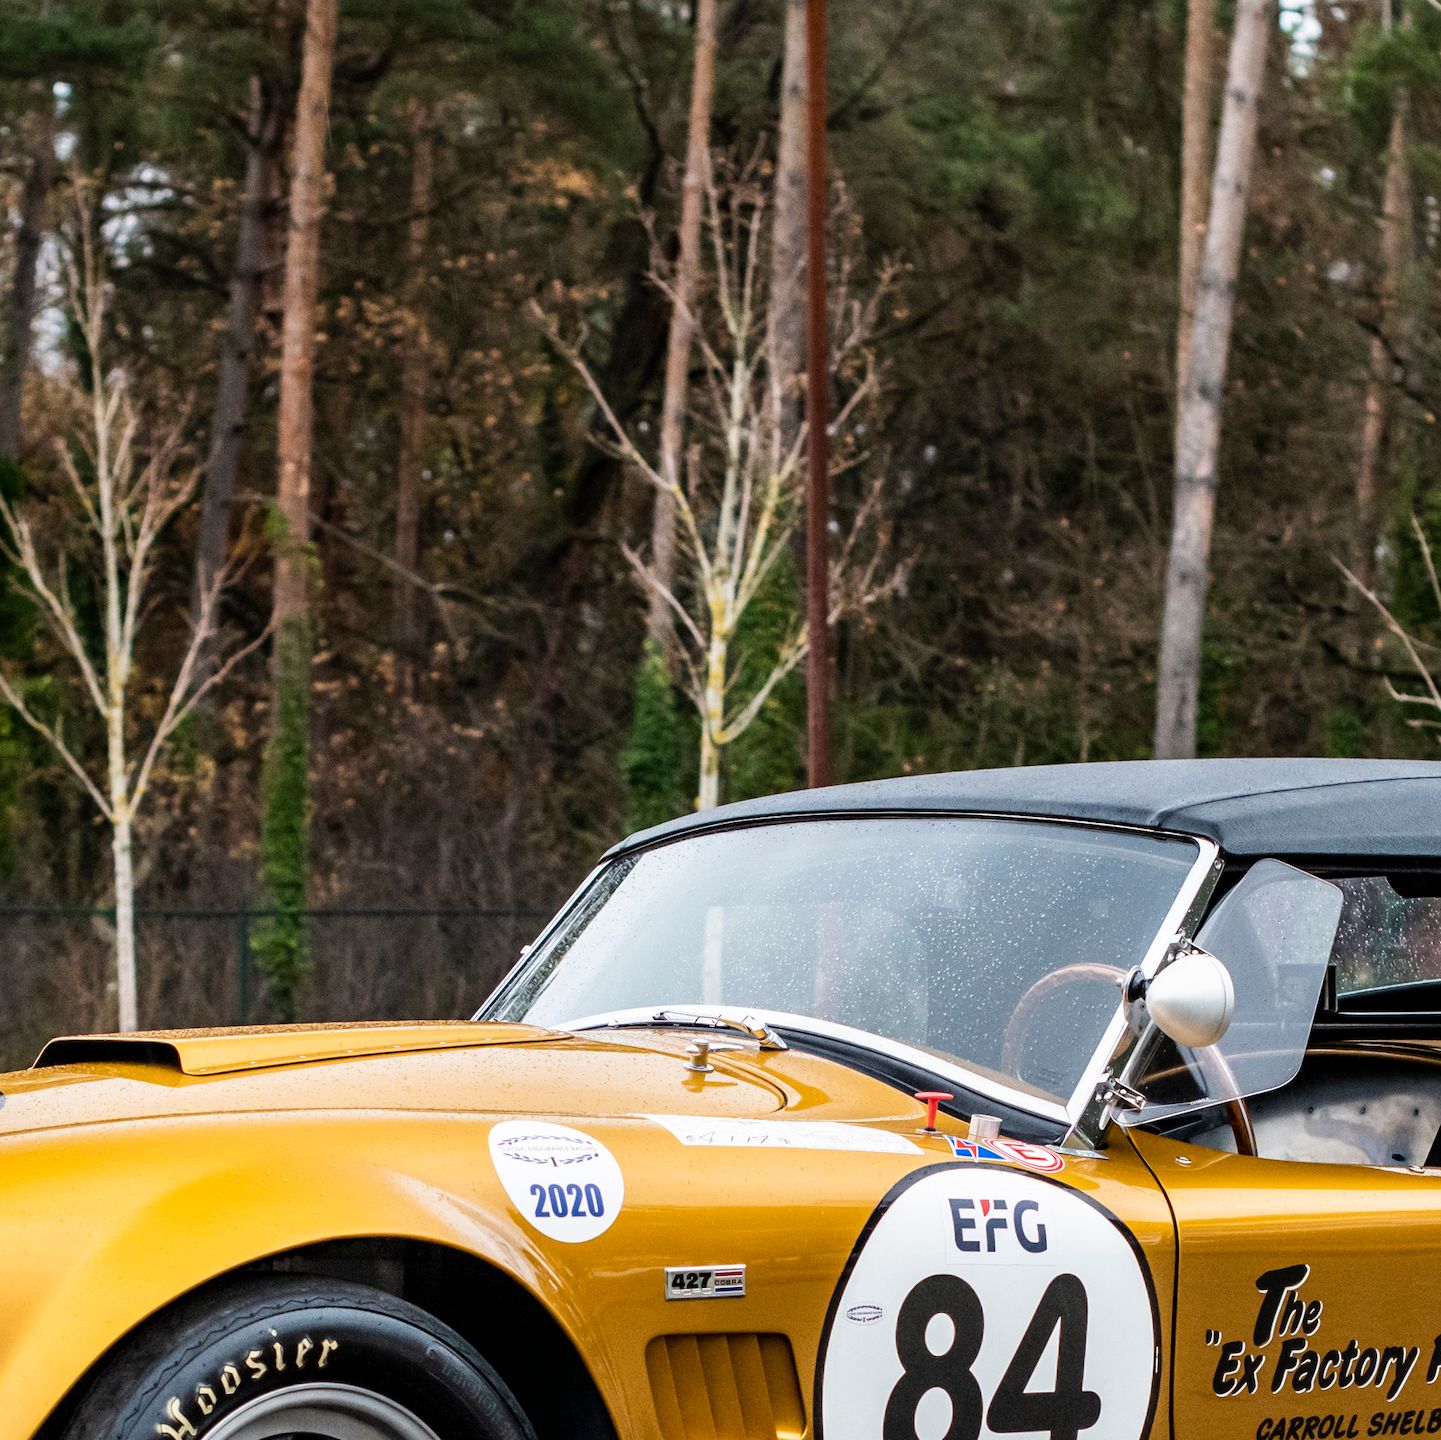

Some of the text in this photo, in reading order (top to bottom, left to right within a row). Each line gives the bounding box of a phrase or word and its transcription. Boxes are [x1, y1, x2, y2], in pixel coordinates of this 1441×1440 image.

[530, 1183, 605, 1218] 2020
[948, 1198, 1048, 1254] EFG
[671, 1272, 712, 1290] 427
[1255, 1264, 1323, 1347] The
[1270, 1338, 1420, 1402] Factory
